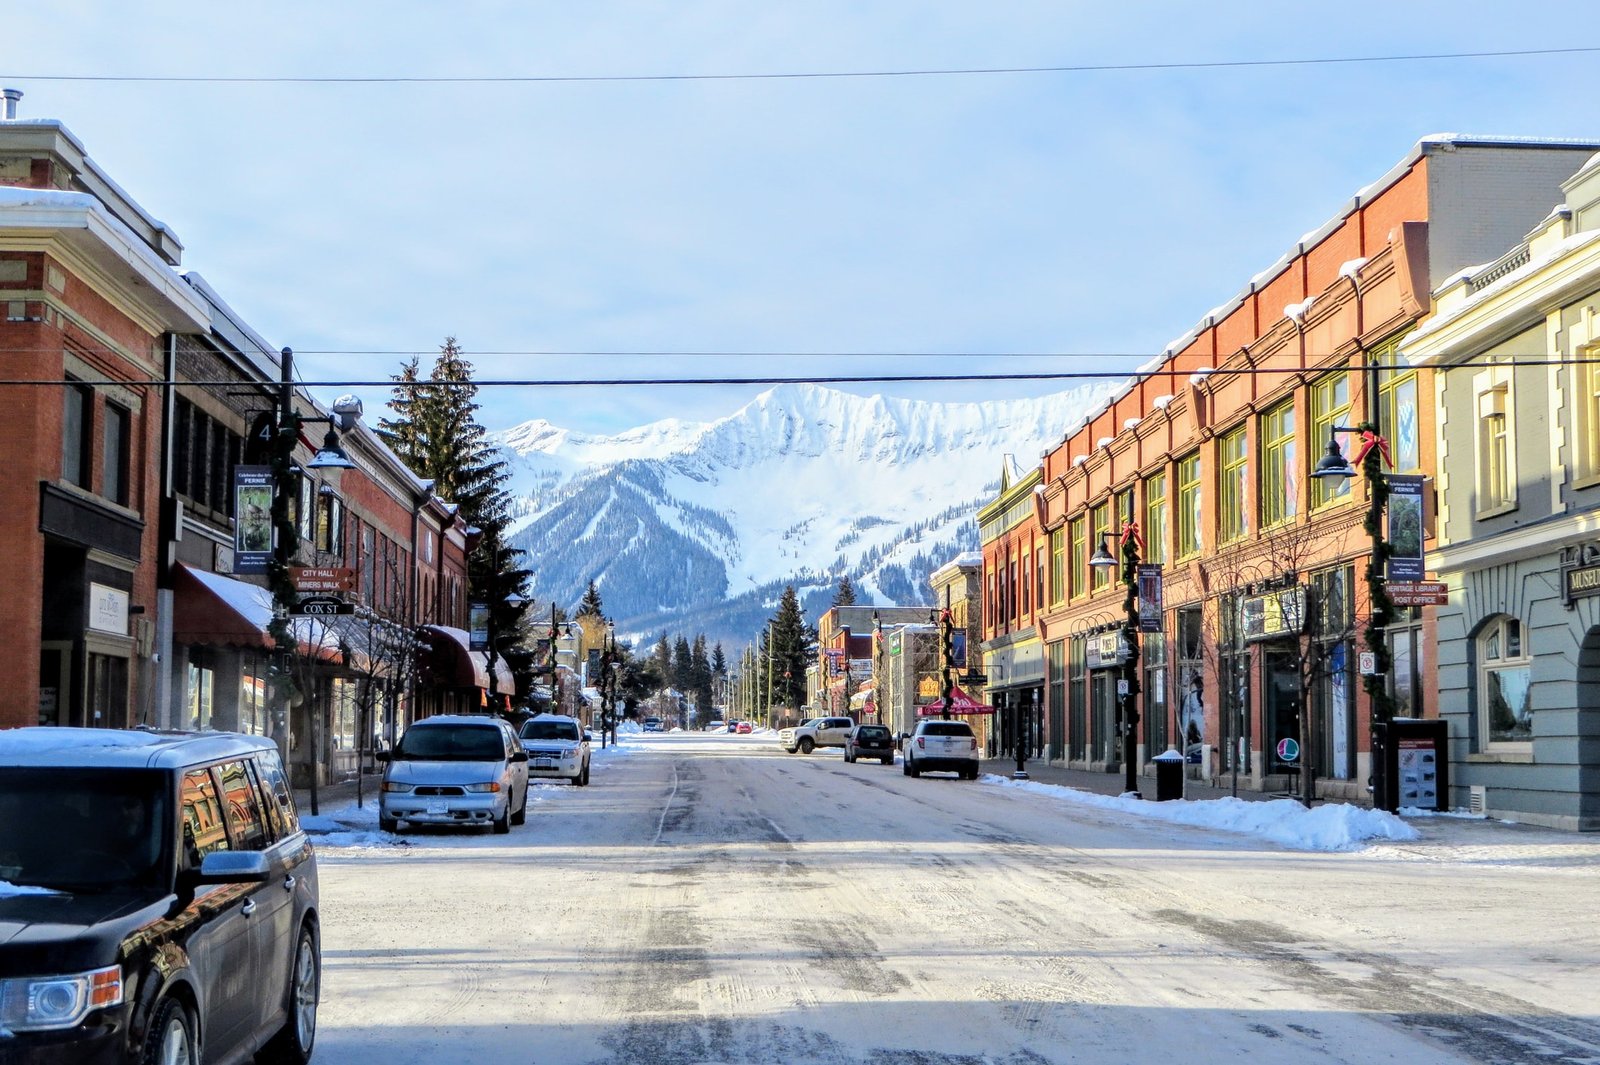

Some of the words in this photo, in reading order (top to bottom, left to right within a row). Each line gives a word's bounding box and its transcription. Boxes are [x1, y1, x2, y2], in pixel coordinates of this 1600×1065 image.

[259, 424, 271, 441] 4
[1571, 569, 1600, 589] MUSEU
[304, 604, 324, 614] COX
[326, 604, 339, 614] ST
